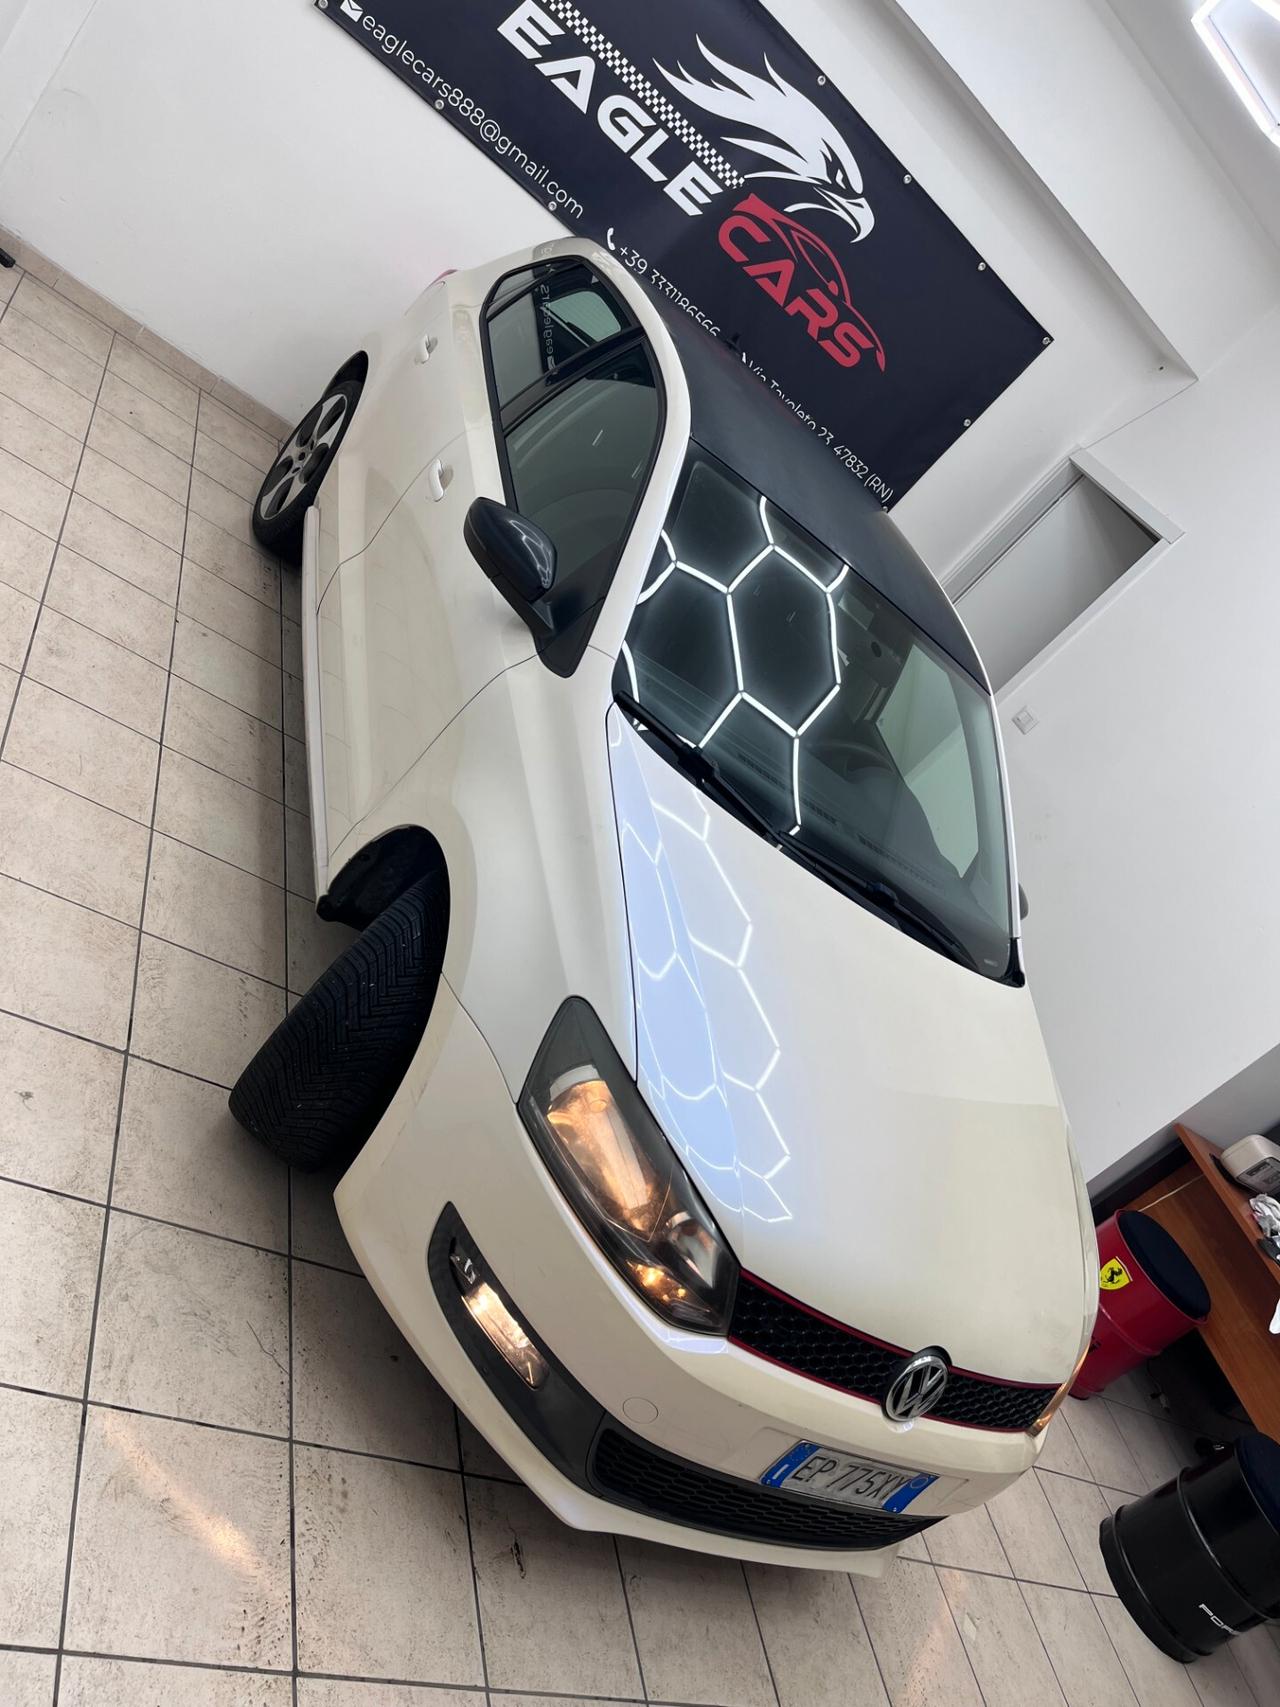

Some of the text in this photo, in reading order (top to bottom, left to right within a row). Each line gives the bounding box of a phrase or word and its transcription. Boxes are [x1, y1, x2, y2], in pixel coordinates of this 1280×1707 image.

[362, 13, 584, 219] eaglecars888@gmail.com
[497, 0, 724, 216] EAGLE
[718, 215, 875, 368] CARS
[833, 445, 869, 479] 47832
[863, 473, 894, 503] (RN)
[791, 1455, 837, 1482] EP
